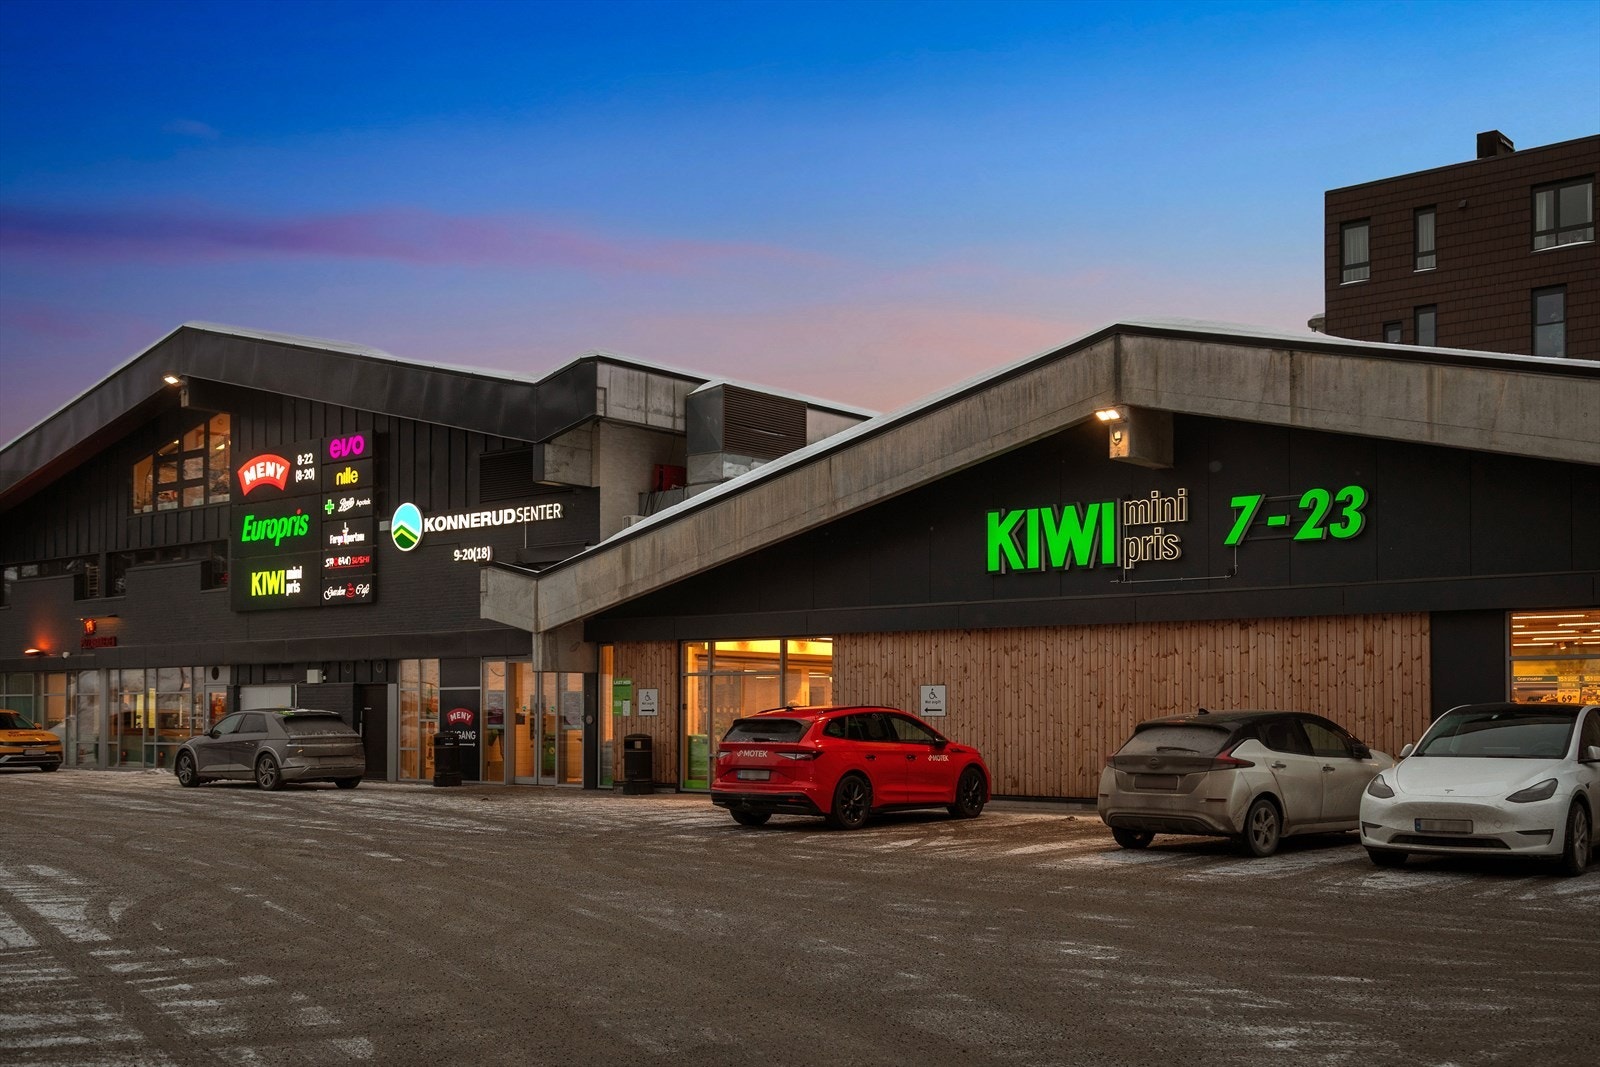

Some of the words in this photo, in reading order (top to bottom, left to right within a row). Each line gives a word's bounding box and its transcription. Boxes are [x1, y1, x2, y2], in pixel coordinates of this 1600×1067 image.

[329, 434, 365, 459] evo
[296, 452, 314, 466] 8-22
[243, 461, 286, 486] MENY
[295, 467, 315, 483] (8-20)
[335, 466, 359, 486] nille
[1123, 487, 1189, 526] mini
[241, 508, 310, 547] Europris
[424, 503, 562, 533] KONNERUDSENTER
[987, 502, 1116, 573] KIWI
[453, 546, 491, 562] 9-20(18)
[1123, 526, 1182, 569] pris
[351, 555, 370, 565] SUSHI
[286, 565, 303, 580] mini
[251, 569, 286, 597] KIWI
[285, 579, 302, 597] pris
[449, 711, 472, 722] MENY
[743, 749, 769, 758] MOTEK
[932, 754, 950, 762] MOTEK
